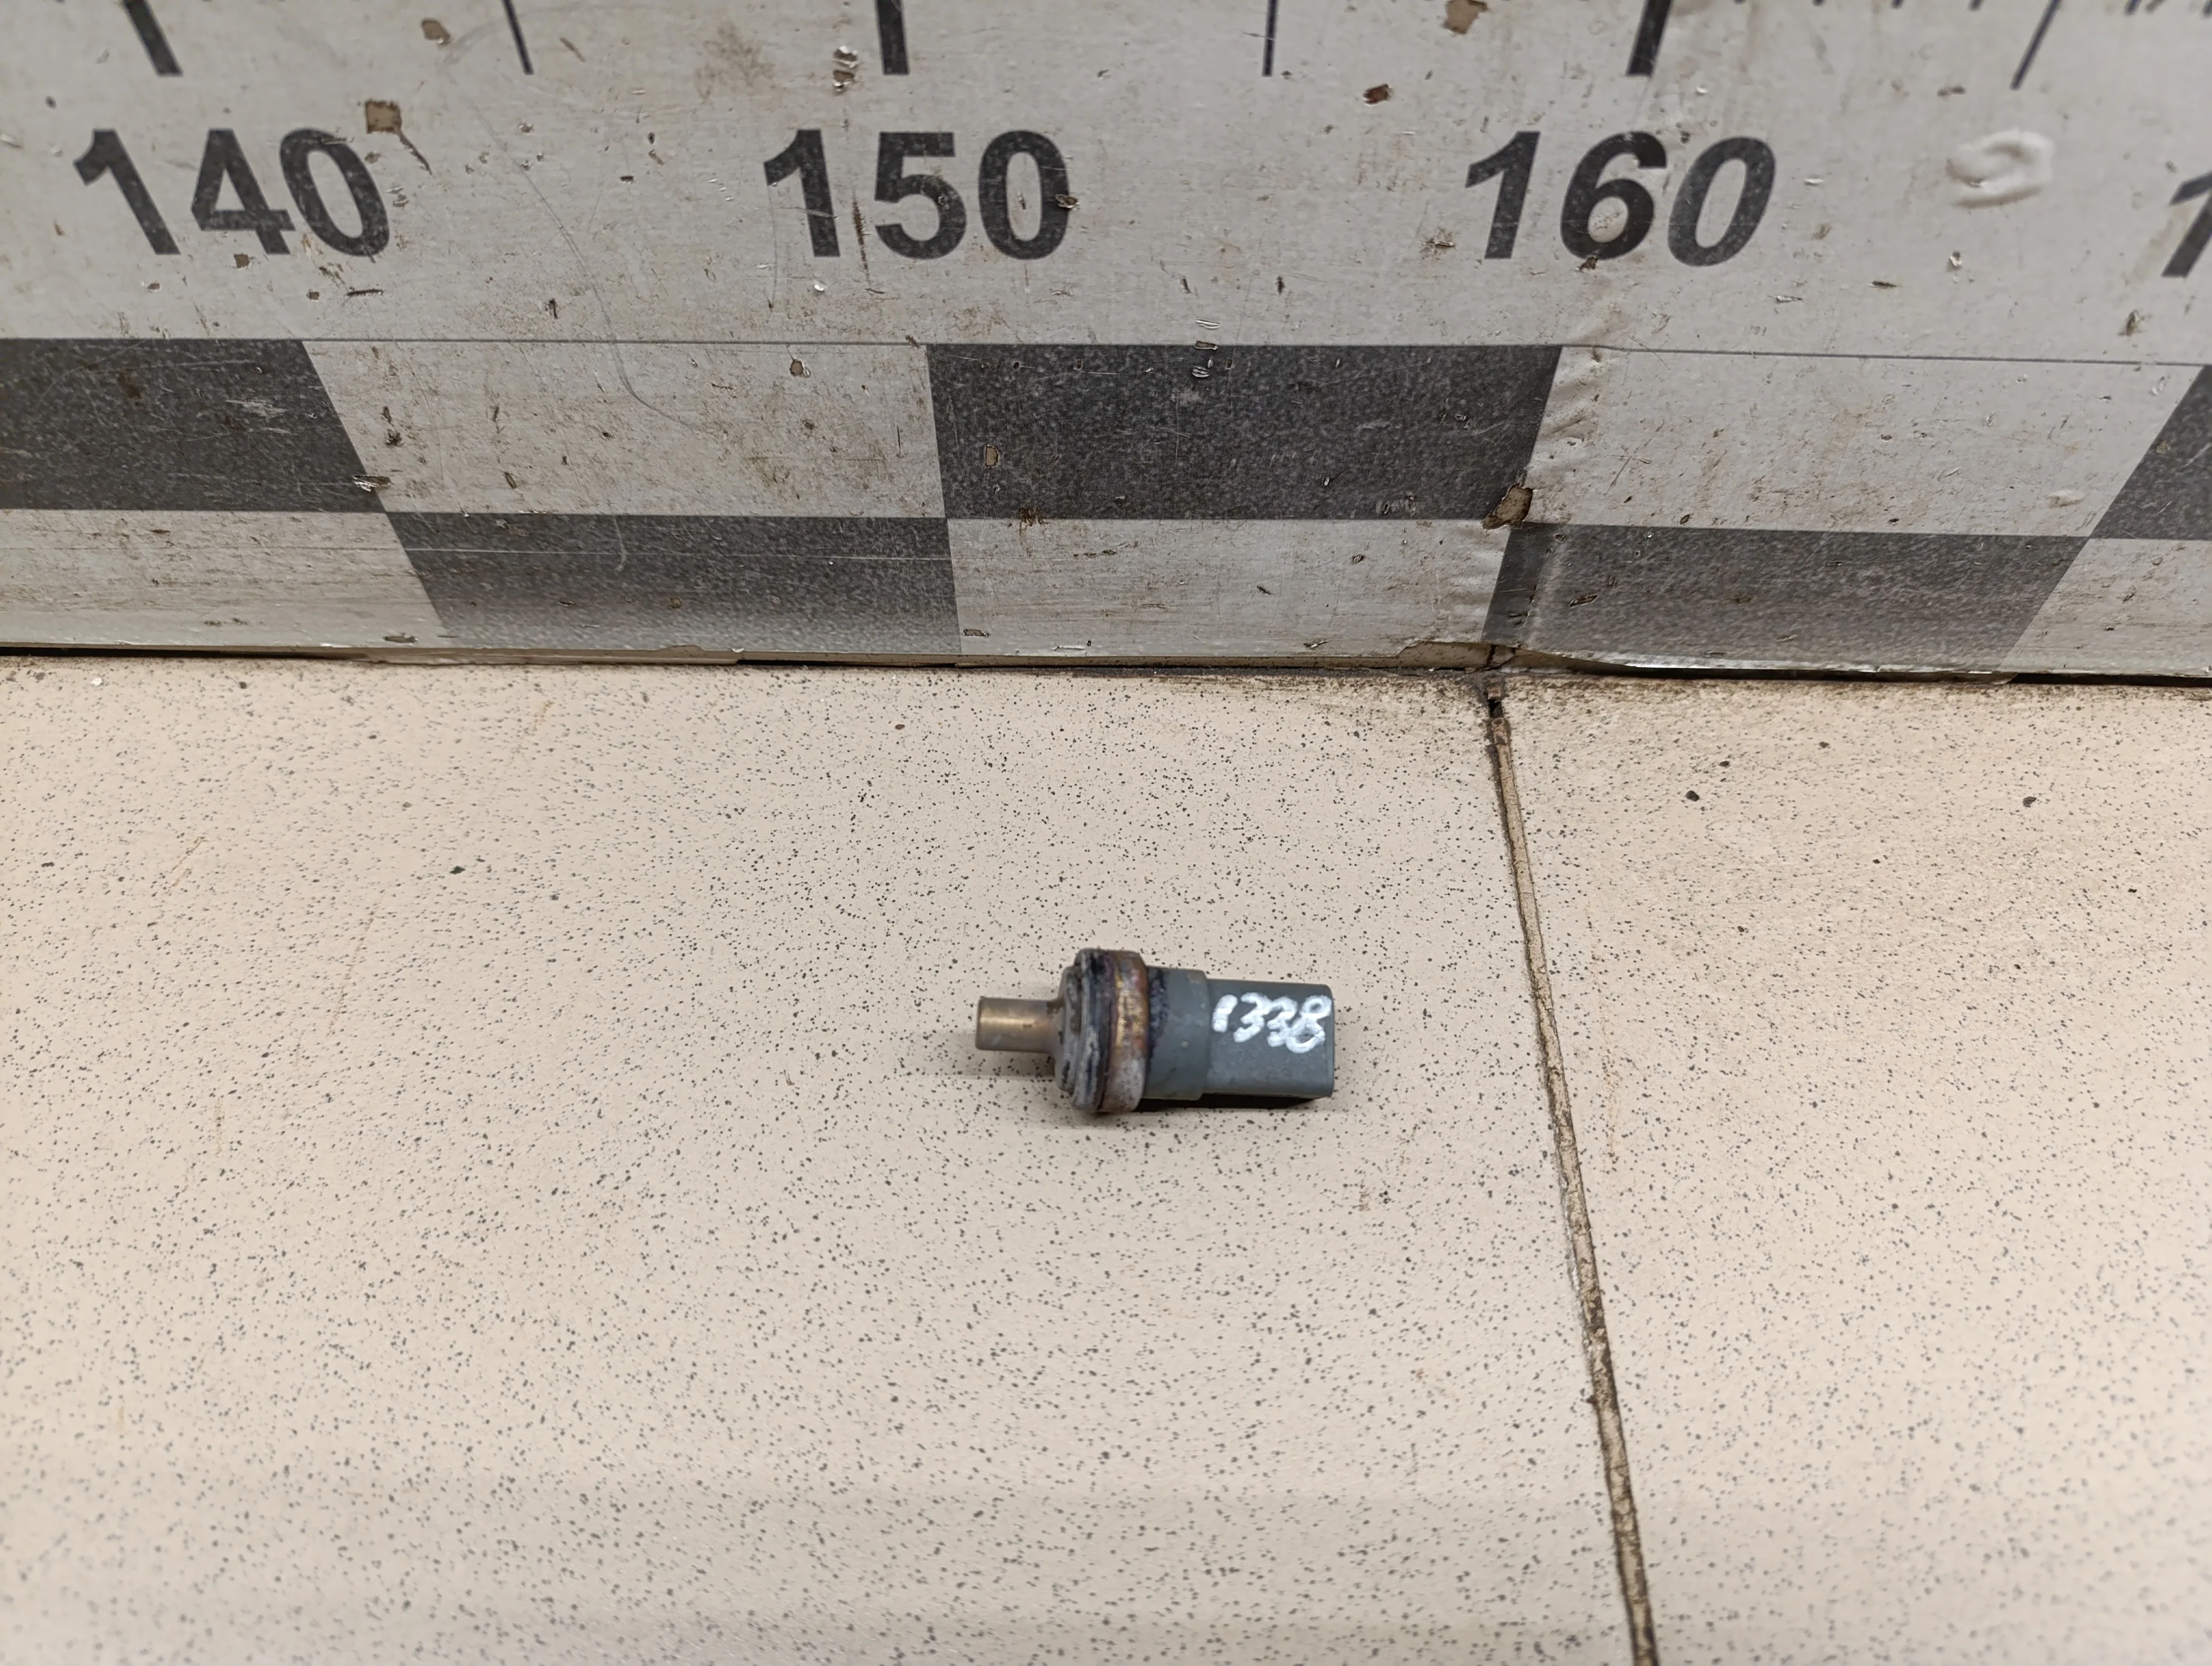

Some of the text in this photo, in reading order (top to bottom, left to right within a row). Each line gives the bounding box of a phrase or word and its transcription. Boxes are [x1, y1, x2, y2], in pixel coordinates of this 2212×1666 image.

[73, 128, 390, 257] 140
[763, 129, 1072, 260] 150
[1464, 130, 1776, 267] 160
[1212, 992, 1332, 1054] 1338
